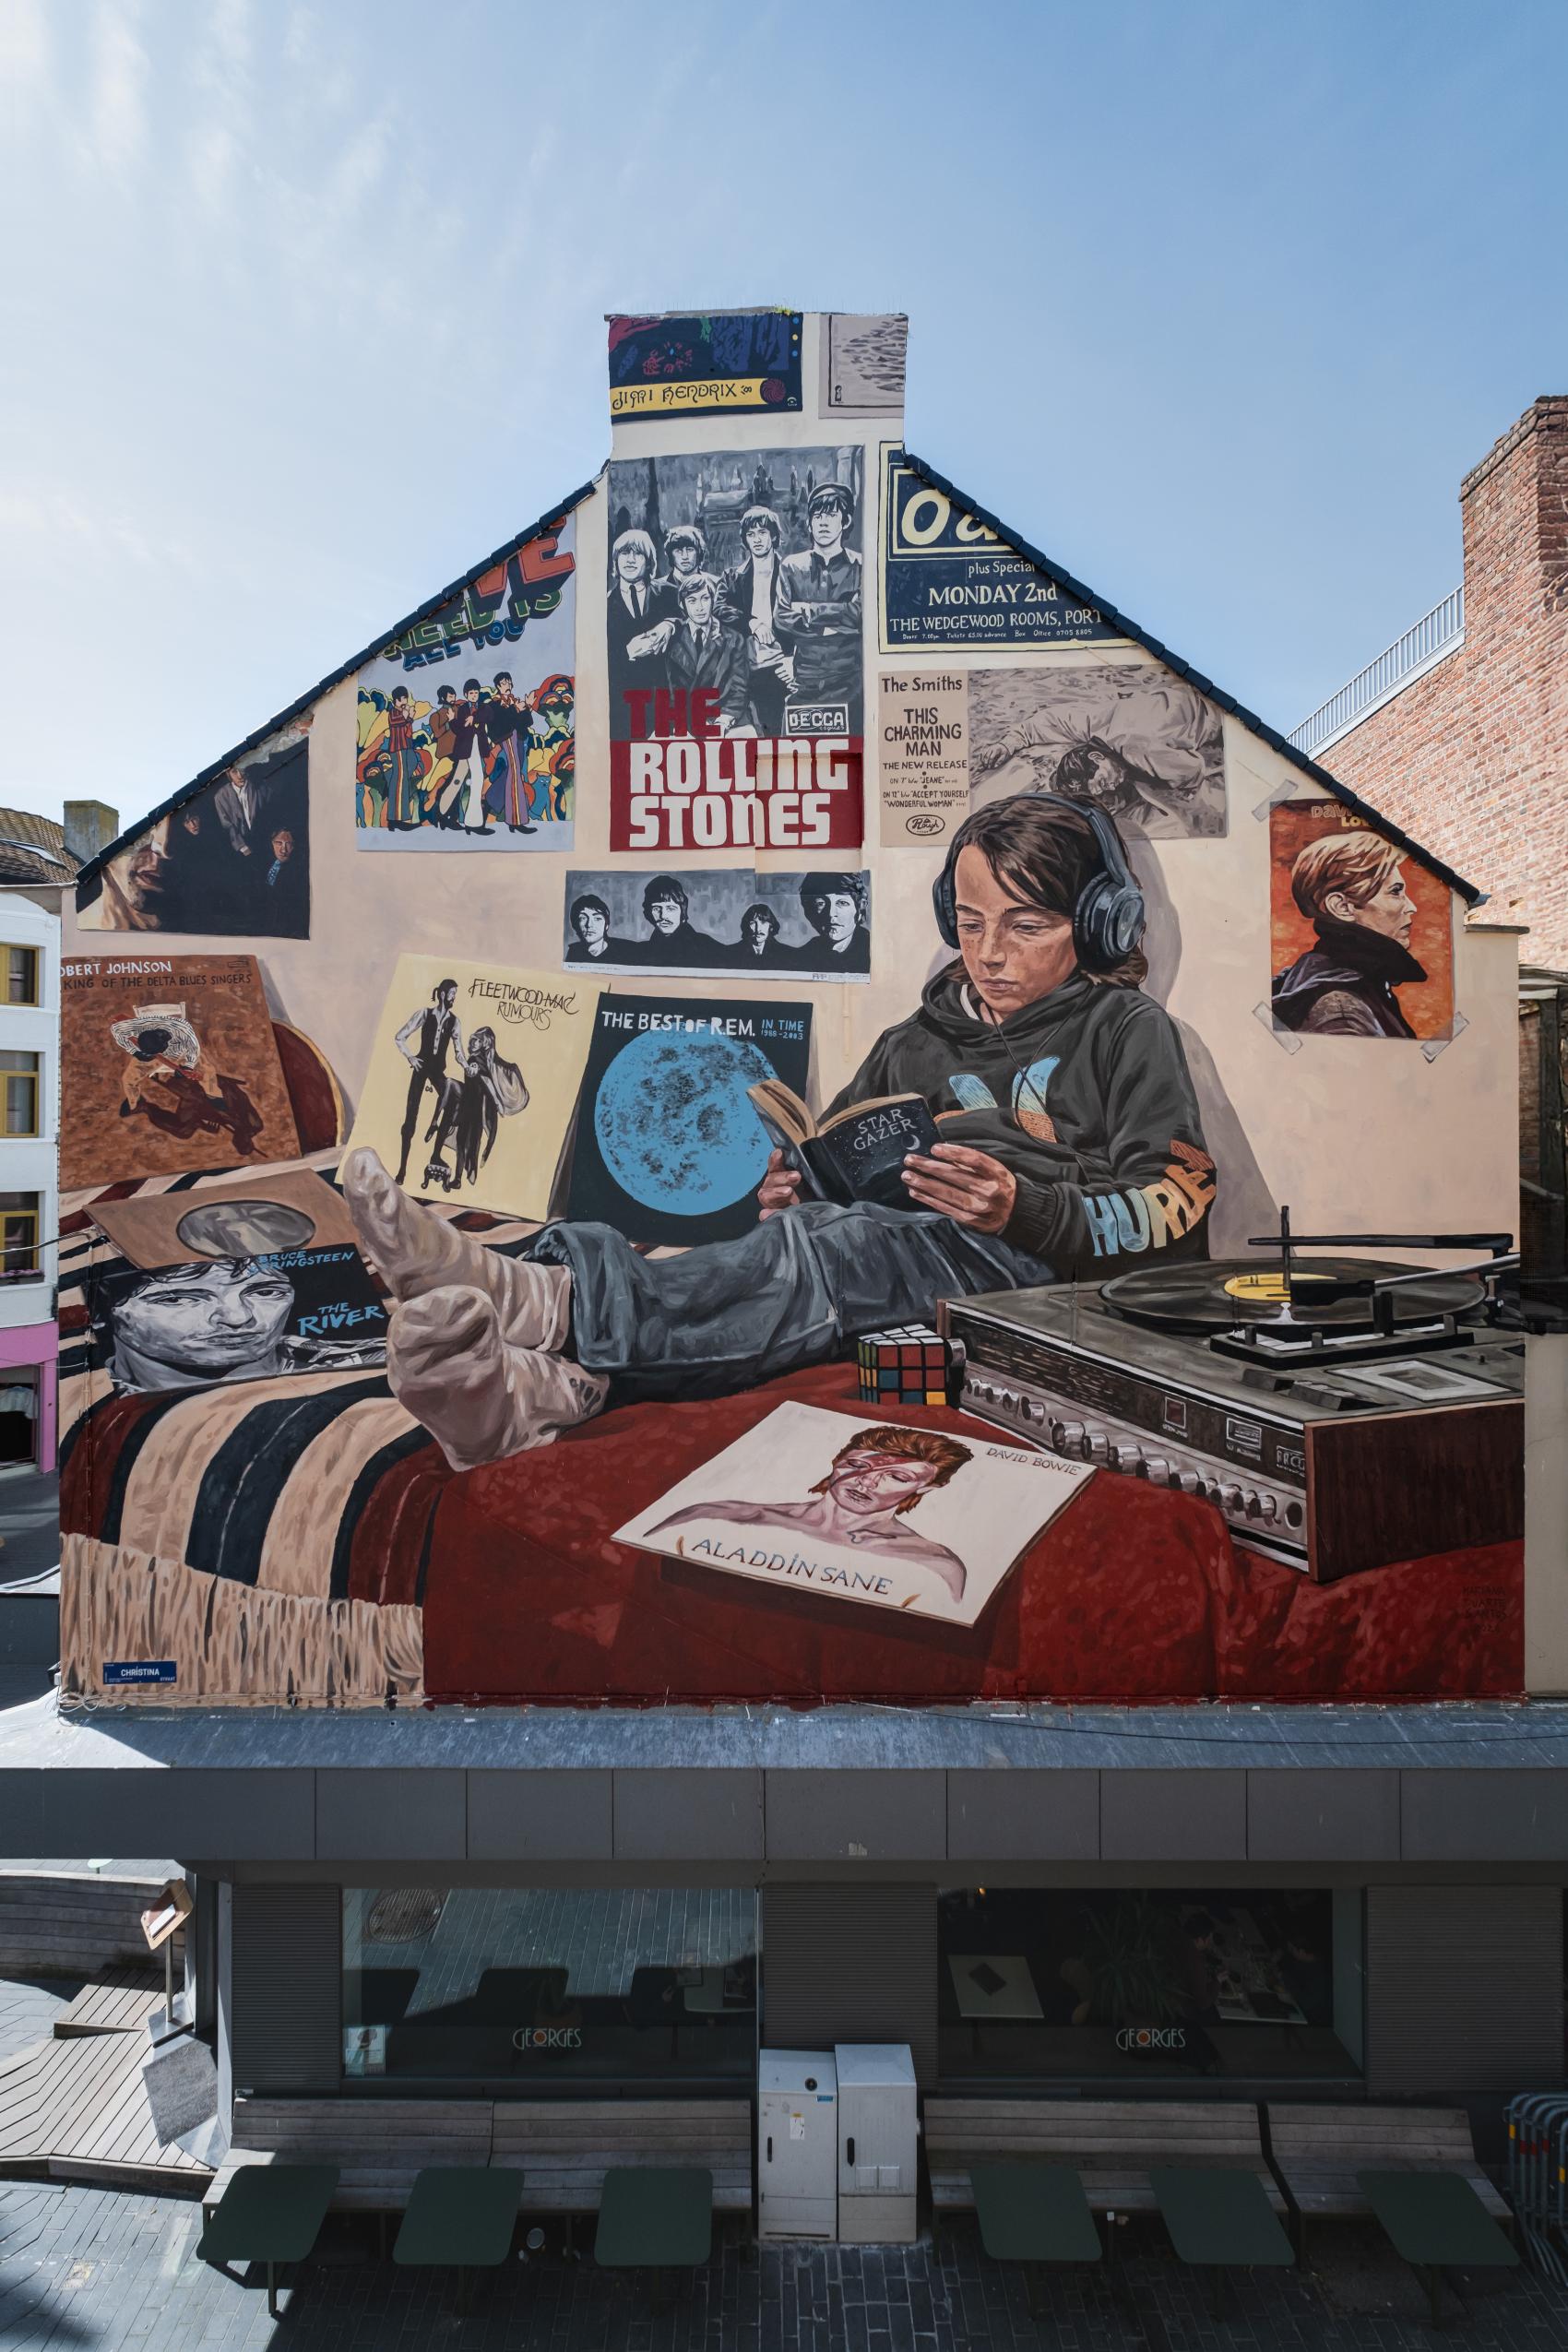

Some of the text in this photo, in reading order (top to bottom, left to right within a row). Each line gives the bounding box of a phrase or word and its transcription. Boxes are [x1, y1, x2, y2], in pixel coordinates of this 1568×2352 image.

[662, 382, 737, 405] HENDRIX
[968, 560, 1035, 578] plus Special
[929, 582, 1058, 606] MONDAY 2nd
[890, 618, 920, 631] THE
[922, 613, 1004, 631] WEDGEWOOD
[1010, 612, 1062, 626] ROOMS,
[1015, 629, 1026, 637] Box
[882, 675, 963, 693] The Smiths
[623, 686, 721, 738] THE
[789, 711, 844, 727] DECCA
[904, 707, 939, 724] THIS
[884, 723, 962, 742] CHARMING
[906, 742, 942, 756] MAN
[630, 739, 849, 793] ROLLING
[883, 759, 968, 770] THE NEW RELEASE
[939, 790, 969, 798] YOURSELF
[629, 792, 831, 848] STONES
[106, 960, 172, 975] JOHNSON
[64, 973, 253, 991] KING OF THE DELTA BLUES SINGERS
[496, 1001, 553, 1030] RUMOURS
[601, 1011, 635, 1029] THE
[637, 1013, 683, 1031] BEST
[684, 1019, 707, 1033] OF
[761, 1018, 805, 1032] IN TIME
[857, 1109, 905, 1134] STAR
[853, 1118, 918, 1150] GAZER
[257, 1250, 307, 1264] BRUCE
[317, 1301, 350, 1314] THE
[297, 1304, 385, 1336] RIVER
[986, 1447, 1082, 1476] DAVID BOWIE
[820, 1566, 894, 1596] SANE
[512, 2027, 583, 2050] GEORGES
[1115, 2027, 1187, 2050] GEORGES
